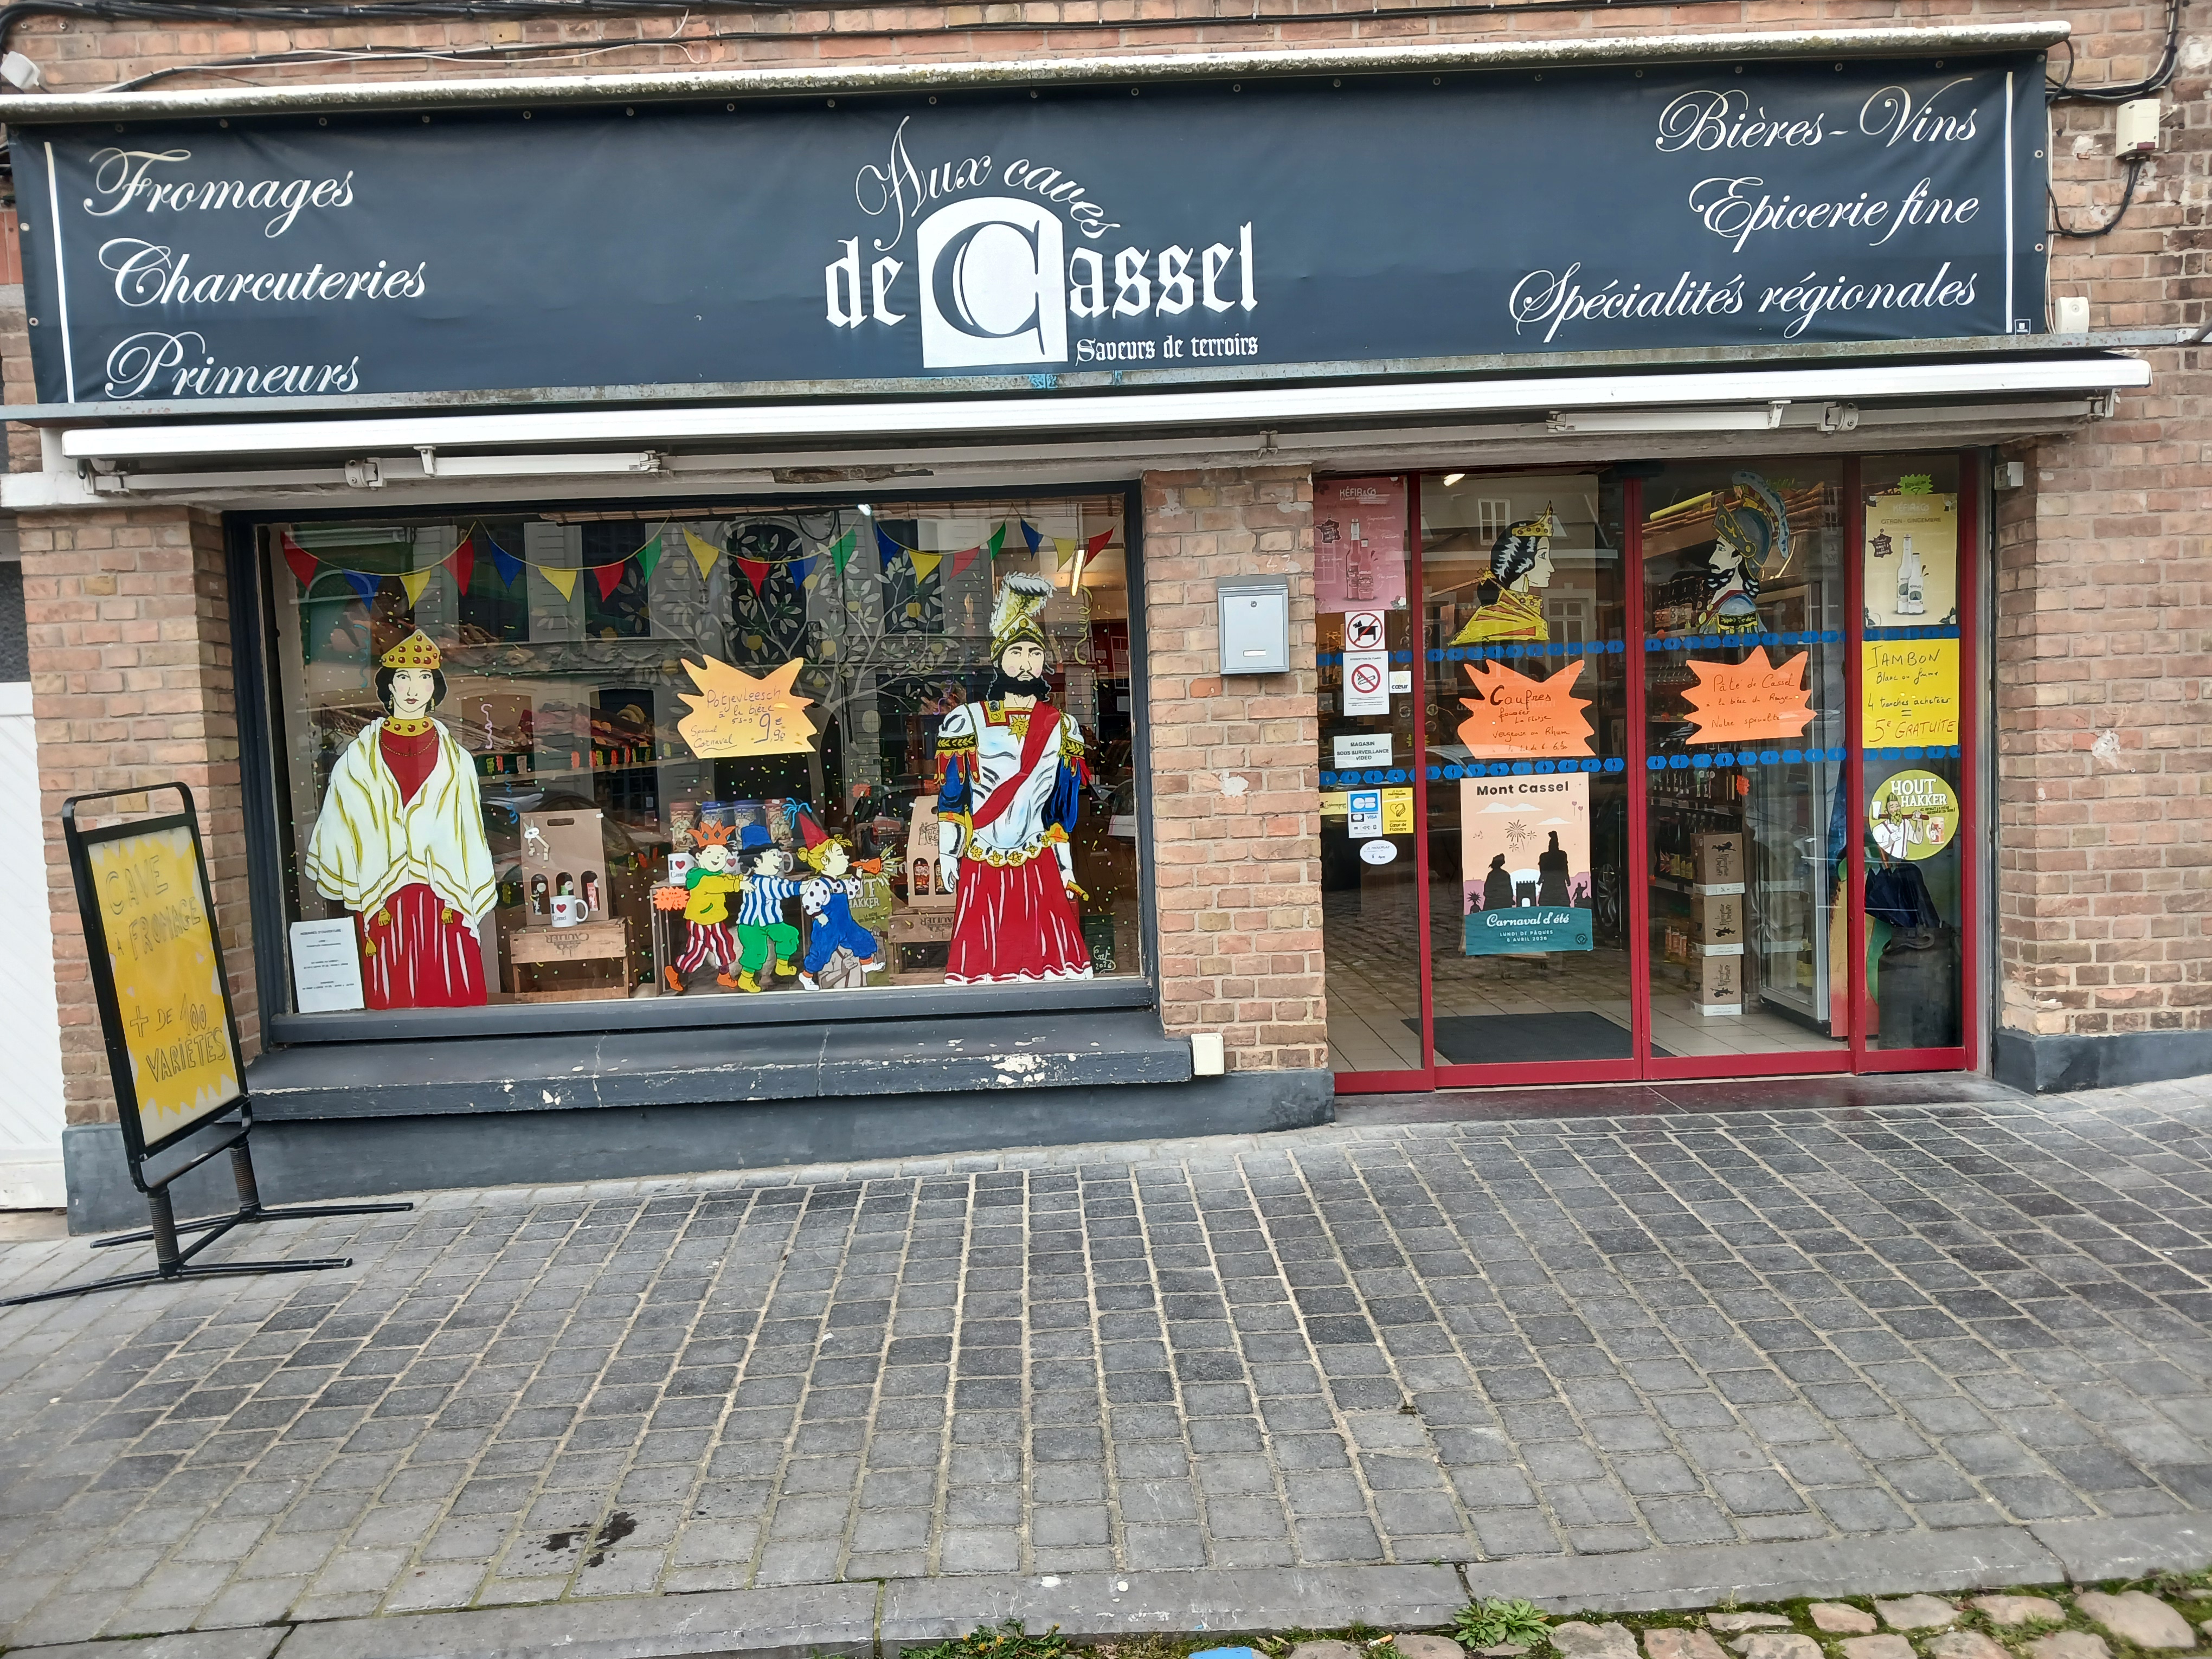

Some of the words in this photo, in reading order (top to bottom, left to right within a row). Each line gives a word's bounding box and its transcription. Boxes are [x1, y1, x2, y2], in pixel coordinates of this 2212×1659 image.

[1655, 89, 1825, 152] Bières
[1859, 77, 1977, 147] Vins
[83, 147, 355, 239] Fromages
[854, 114, 992, 252] Aux
[1003, 158, 1121, 239] caves
[1688, 176, 1889, 253] Epicerie
[1869, 177, 1979, 246] fine
[98, 237, 427, 307] Charcuteries
[825, 235, 906, 329] de
[930, 219, 1259, 356] Cassel
[1509, 261, 1744, 343] Spécialités
[1758, 261, 1977, 339] régionales
[1075, 337, 1156, 366] Saveurs
[1163, 334, 1184, 359] de
[1191, 332, 1259, 357] terroirs
[105, 331, 359, 400] Primeurs
[1867, 645, 1940, 671] JAMBON
[1713, 674, 1742, 692] Pâté
[1747, 678, 1757, 689] de
[1761, 673, 1795, 689] Cassel
[1876, 671, 1898, 685] Blanc
[707, 685, 781, 713] Potjevleesch
[734, 704, 744, 716] la
[1490, 685, 1552, 710] Gaufres
[1868, 692, 1874, 711] 4
[1545, 726, 1570, 736] Rhum
[1711, 715, 1735, 728] Notre
[693, 733, 734, 749] Carnaval
[1476, 784, 1514, 796] Mont
[1518, 781, 1569, 794] Cassel
[1890, 777, 1937, 796] HOUT
[1900, 793, 1948, 808] HAKKER
[106, 854, 169, 916] CAVE
[128, 896, 201, 961] FROMAGE
[1486, 912, 1541, 927] Carnaval
[1542, 912, 1570, 924] d'été
[544, 933, 590, 944] CAULIER
[156, 1008, 173, 1032] DE
[180, 993, 207, 1036] 100
